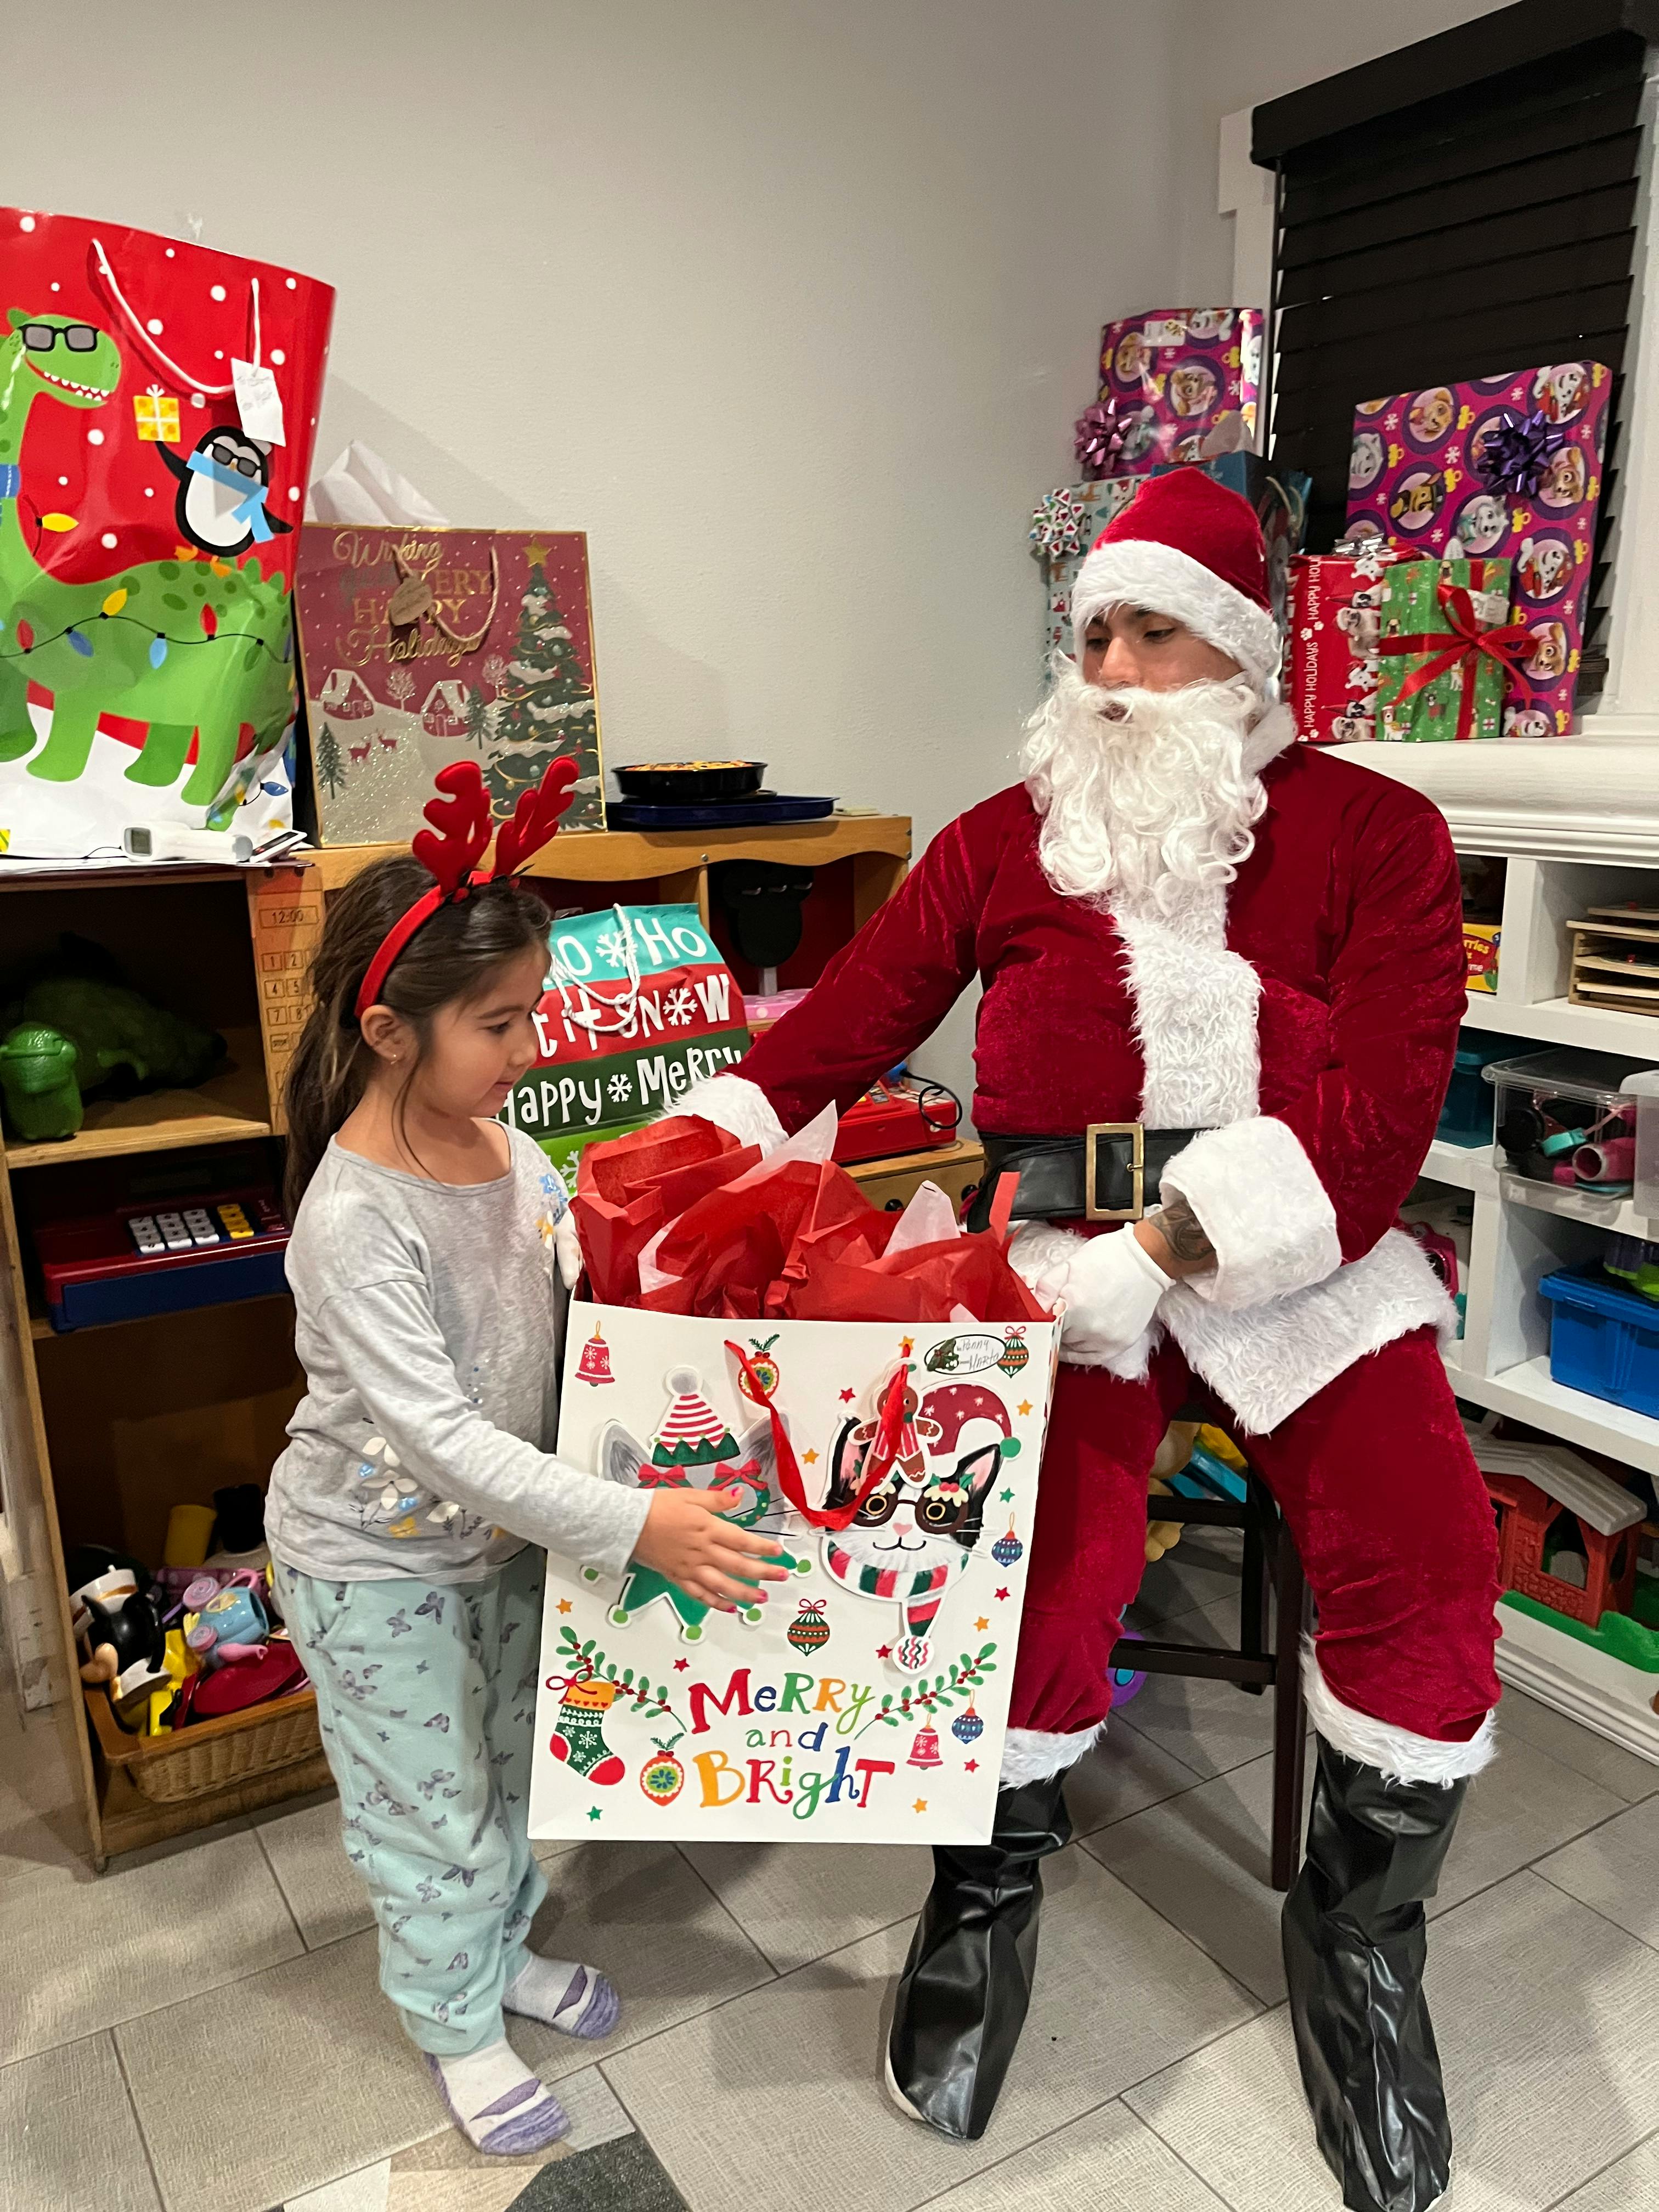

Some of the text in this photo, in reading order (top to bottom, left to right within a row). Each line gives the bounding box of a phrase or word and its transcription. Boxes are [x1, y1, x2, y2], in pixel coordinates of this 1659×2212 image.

[332, 531, 443, 582] Wihing
[420, 569, 493, 595] ERY
[353, 598, 466, 624] HPY
[1307, 585, 1322, 620] HAPPY
[1304, 641, 1319, 728] HAPPY HOLIDAYS
[272, 910, 304, 925] 12:00
[270, 953, 297, 967] 1 2
[274, 1008, 280, 1023] 7
[745, 1722, 828, 1752] and
